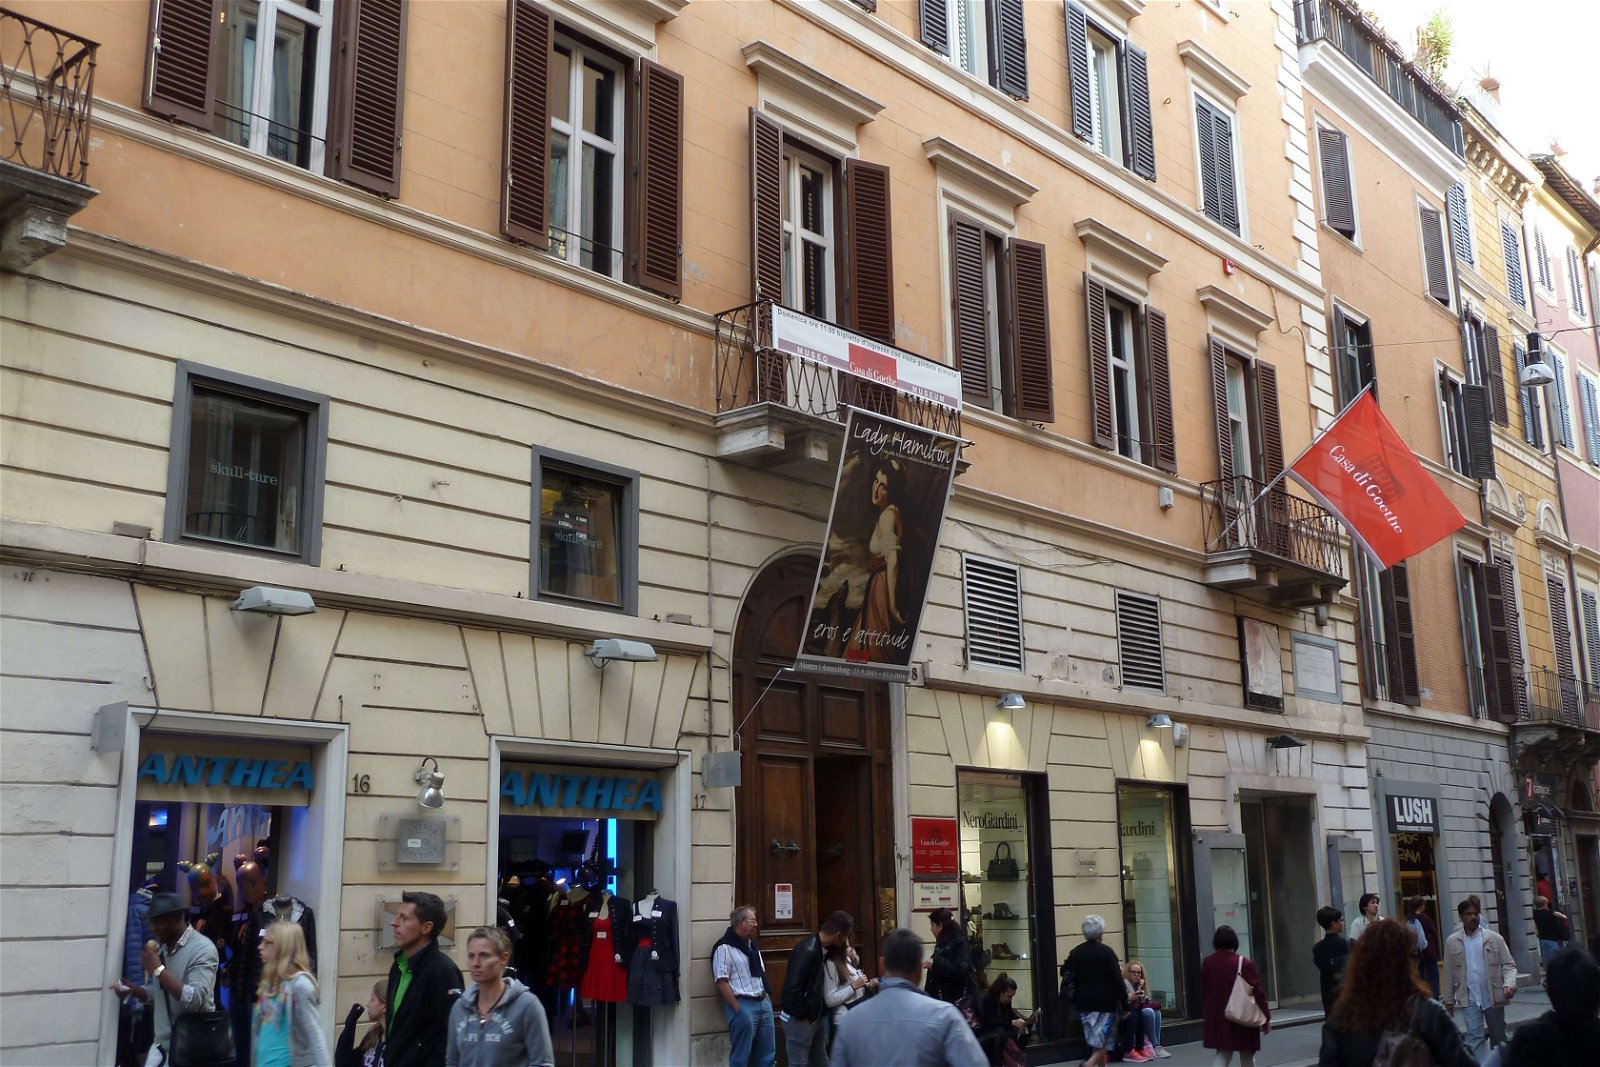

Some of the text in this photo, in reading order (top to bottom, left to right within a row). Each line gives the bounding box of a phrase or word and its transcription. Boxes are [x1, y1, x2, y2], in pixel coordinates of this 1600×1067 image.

[777, 308, 808, 325] Domenica
[809, 320, 819, 330] ore
[836, 330, 860, 345] biglietto
[861, 339, 891, 355] d'ingresso
[890, 350, 901, 358] con
[902, 354, 916, 365] visita
[796, 345, 829, 364] MUSEO
[850, 361, 898, 387] Casa di Goethe
[911, 385, 946, 403] MUSEUM
[853, 422, 889, 456] Lady
[892, 431, 951, 464] Hamilton
[210, 461, 279, 486] skull-ture
[1329, 445, 1402, 534] Casa di Goethe
[813, 622, 840, 641] eros
[842, 626, 853, 643] e
[137, 752, 315, 790] ANTHEA
[352, 773, 371, 793] 16
[500, 770, 664, 813] ANTHEA
[694, 793, 707, 809] 17
[962, 810, 1018, 830] NeroGiardini
[1393, 796, 1433, 824] LUSH
